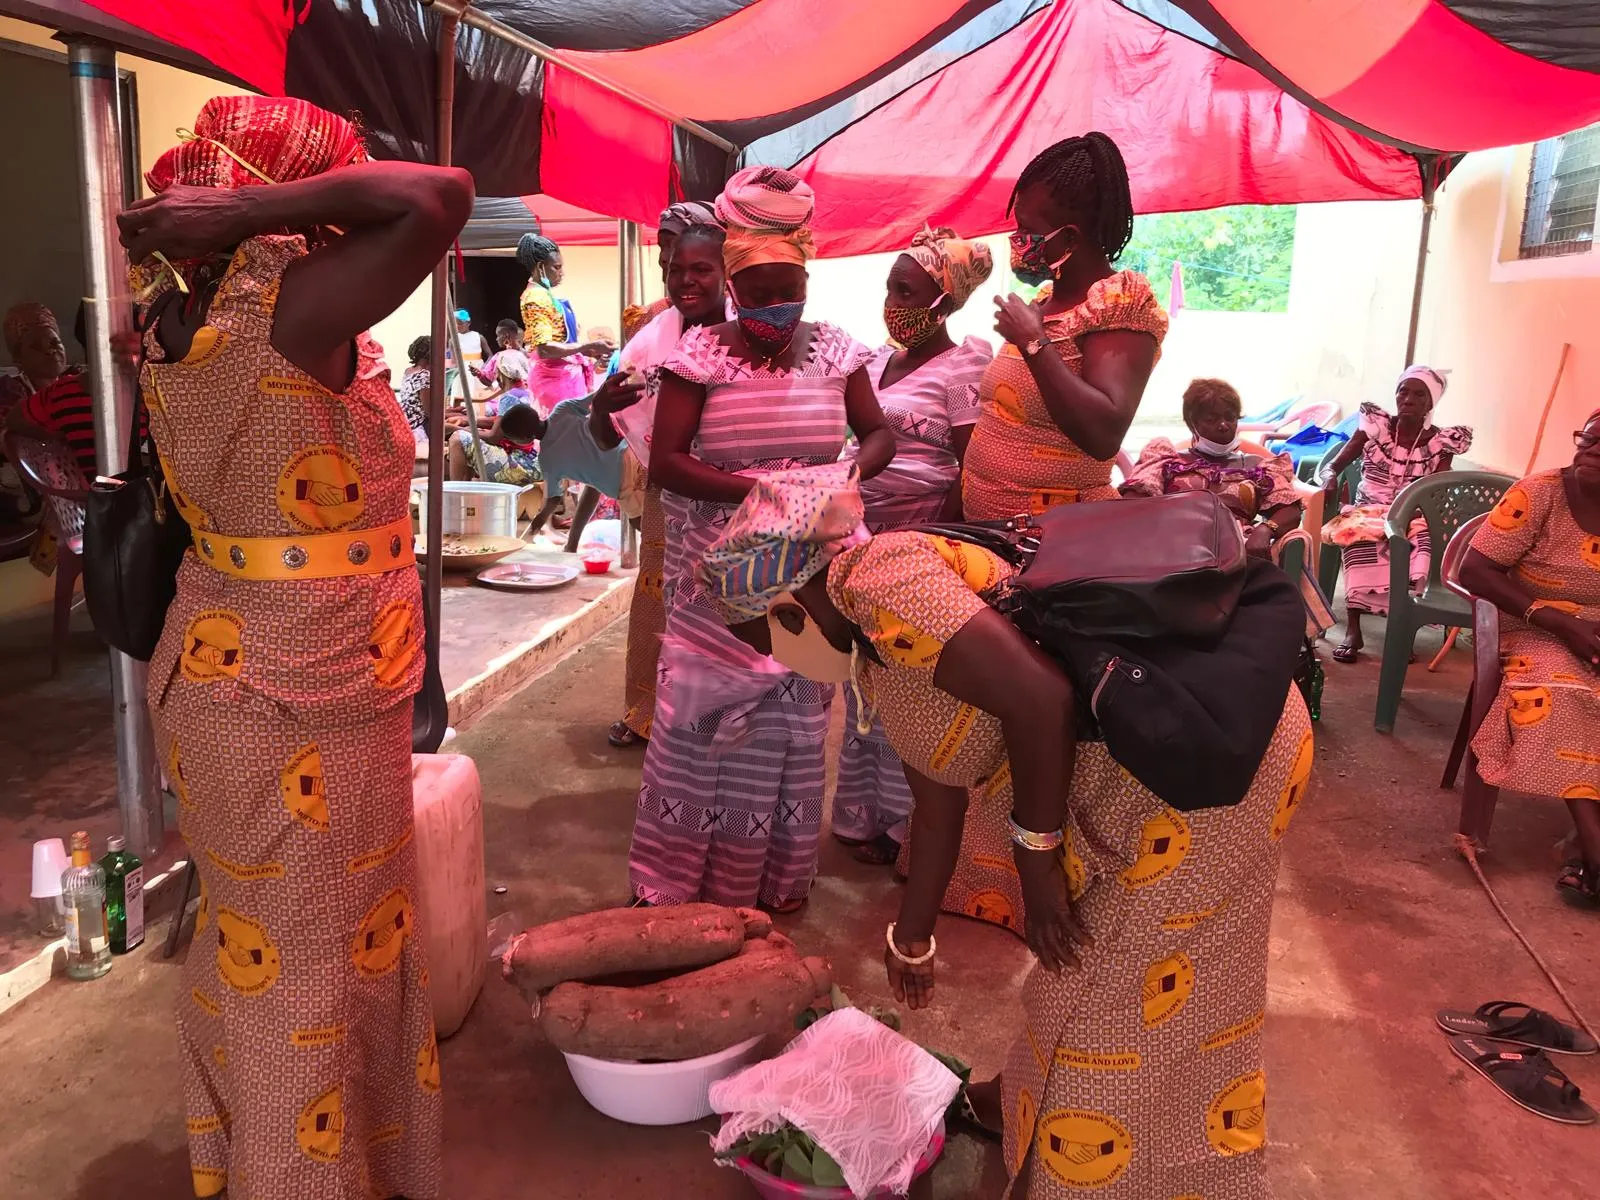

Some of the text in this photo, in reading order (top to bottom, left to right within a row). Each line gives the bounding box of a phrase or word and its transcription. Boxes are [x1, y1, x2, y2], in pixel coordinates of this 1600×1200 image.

[266, 381, 305, 391] MOTTO:
[955, 719, 967, 737] AND
[1151, 1013, 1167, 1024] AND
[297, 1031, 334, 1042] MOTTO:
[1061, 1052, 1137, 1066] PEACE AND LOVE
[1073, 1111, 1110, 1127] WOMEN'S
[1067, 1177, 1092, 1187] PEACE
